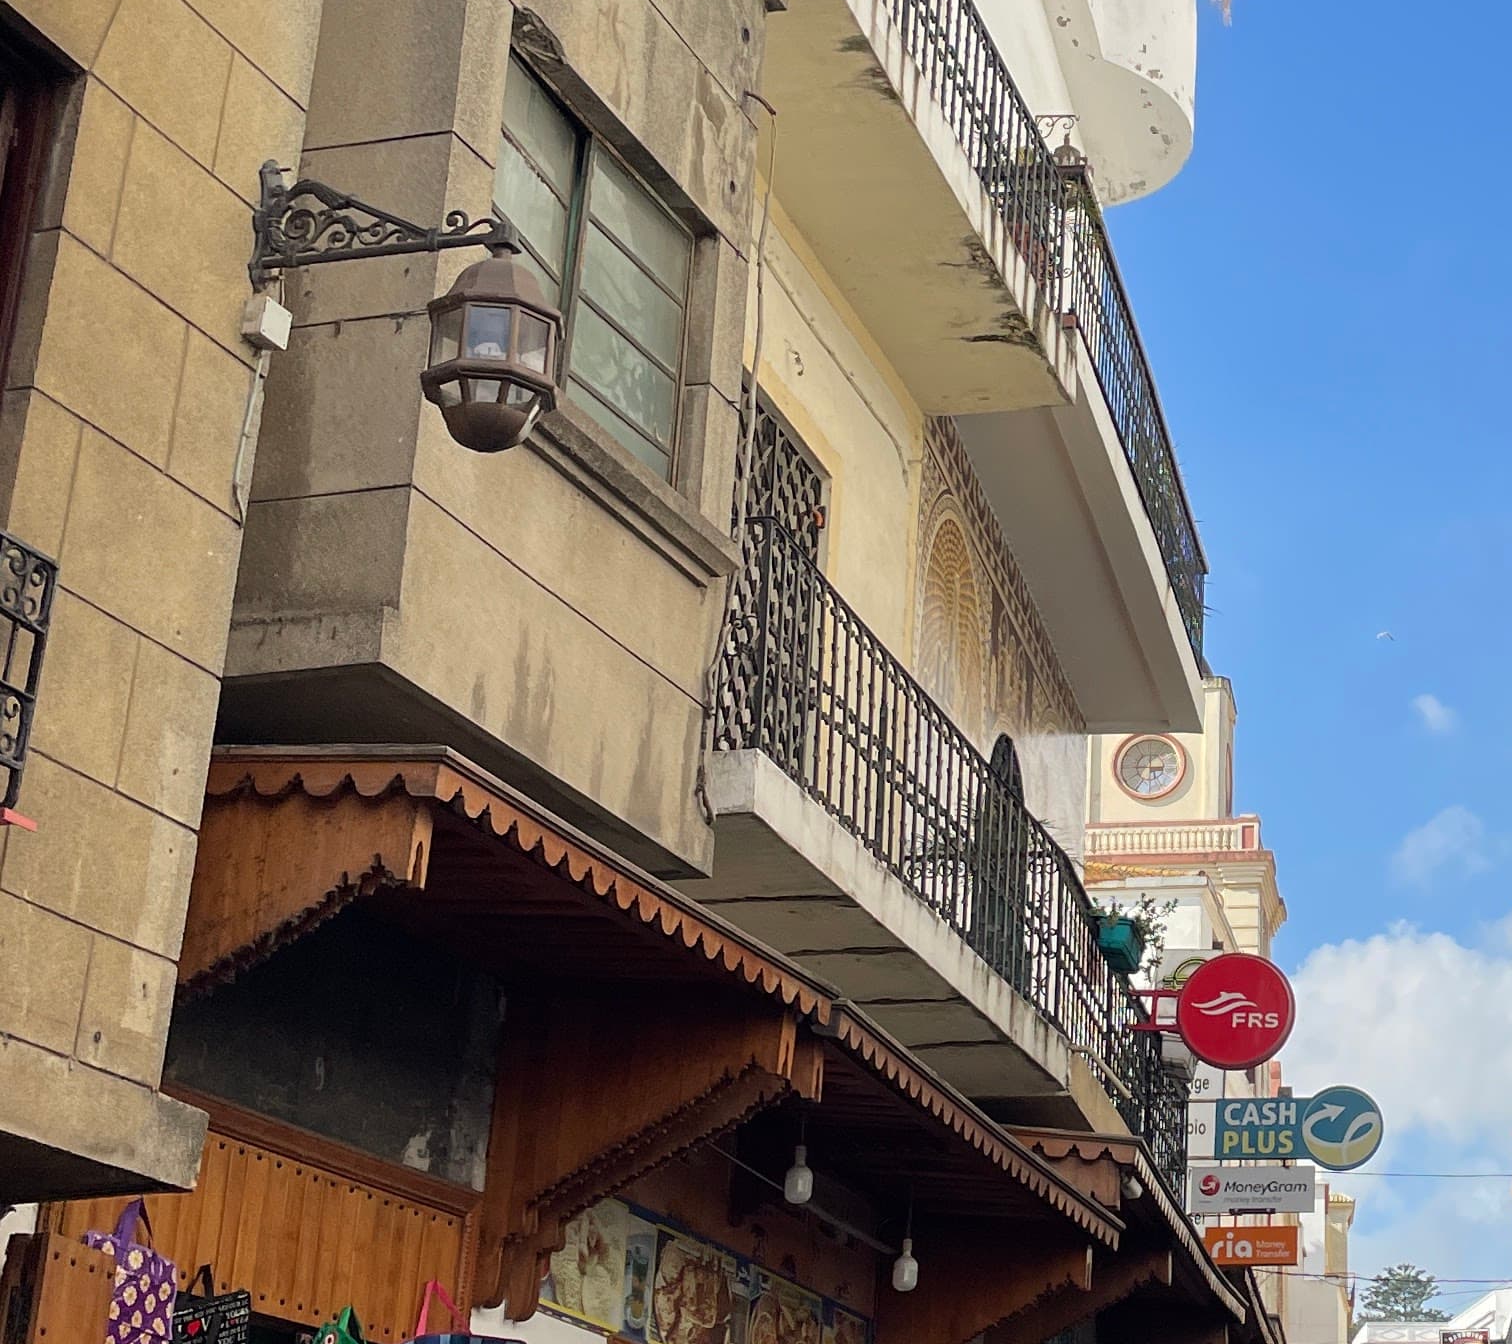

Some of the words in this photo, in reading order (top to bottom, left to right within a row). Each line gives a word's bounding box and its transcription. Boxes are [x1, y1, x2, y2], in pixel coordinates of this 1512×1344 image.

[1231, 1012, 1280, 1029] FRS
[1223, 1102, 1297, 1126] CASH
[1222, 1130, 1294, 1154] PLUS
[1223, 1180, 1308, 1196] MoneyGram
[1211, 1231, 1253, 1259] ria
